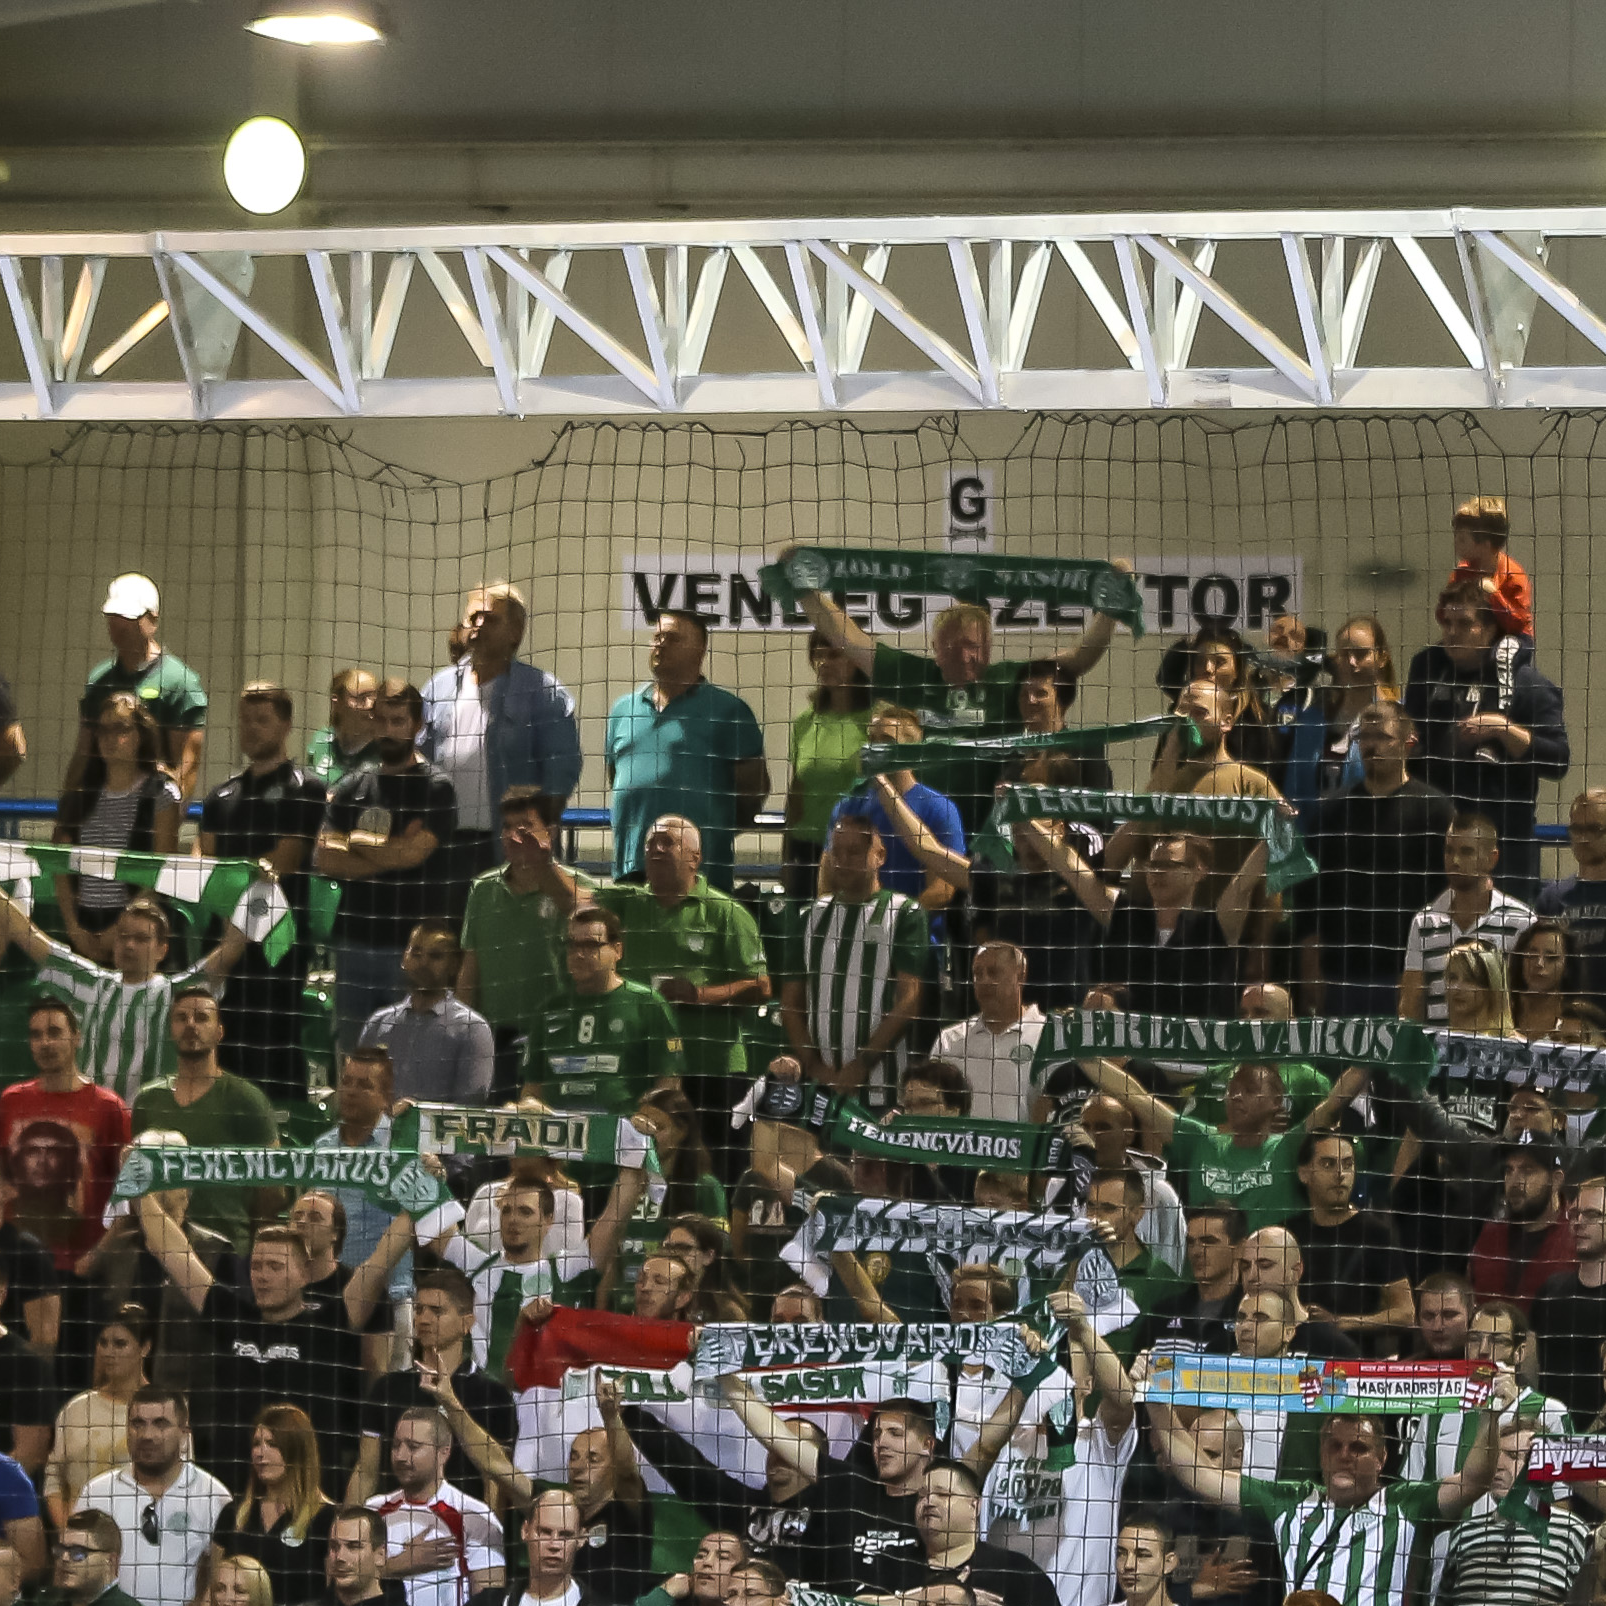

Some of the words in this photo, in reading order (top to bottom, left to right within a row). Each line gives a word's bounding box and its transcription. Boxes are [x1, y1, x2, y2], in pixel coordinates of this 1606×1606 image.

[949, 477, 987, 523] G
[1045, 1010, 1397, 1058] FERENCVAROS
[433, 1115, 587, 1148] FRADI
[162, 1147, 395, 1187] FERENCVAROS
[1356, 1379, 1462, 1401] MAGYARORSZÁG
